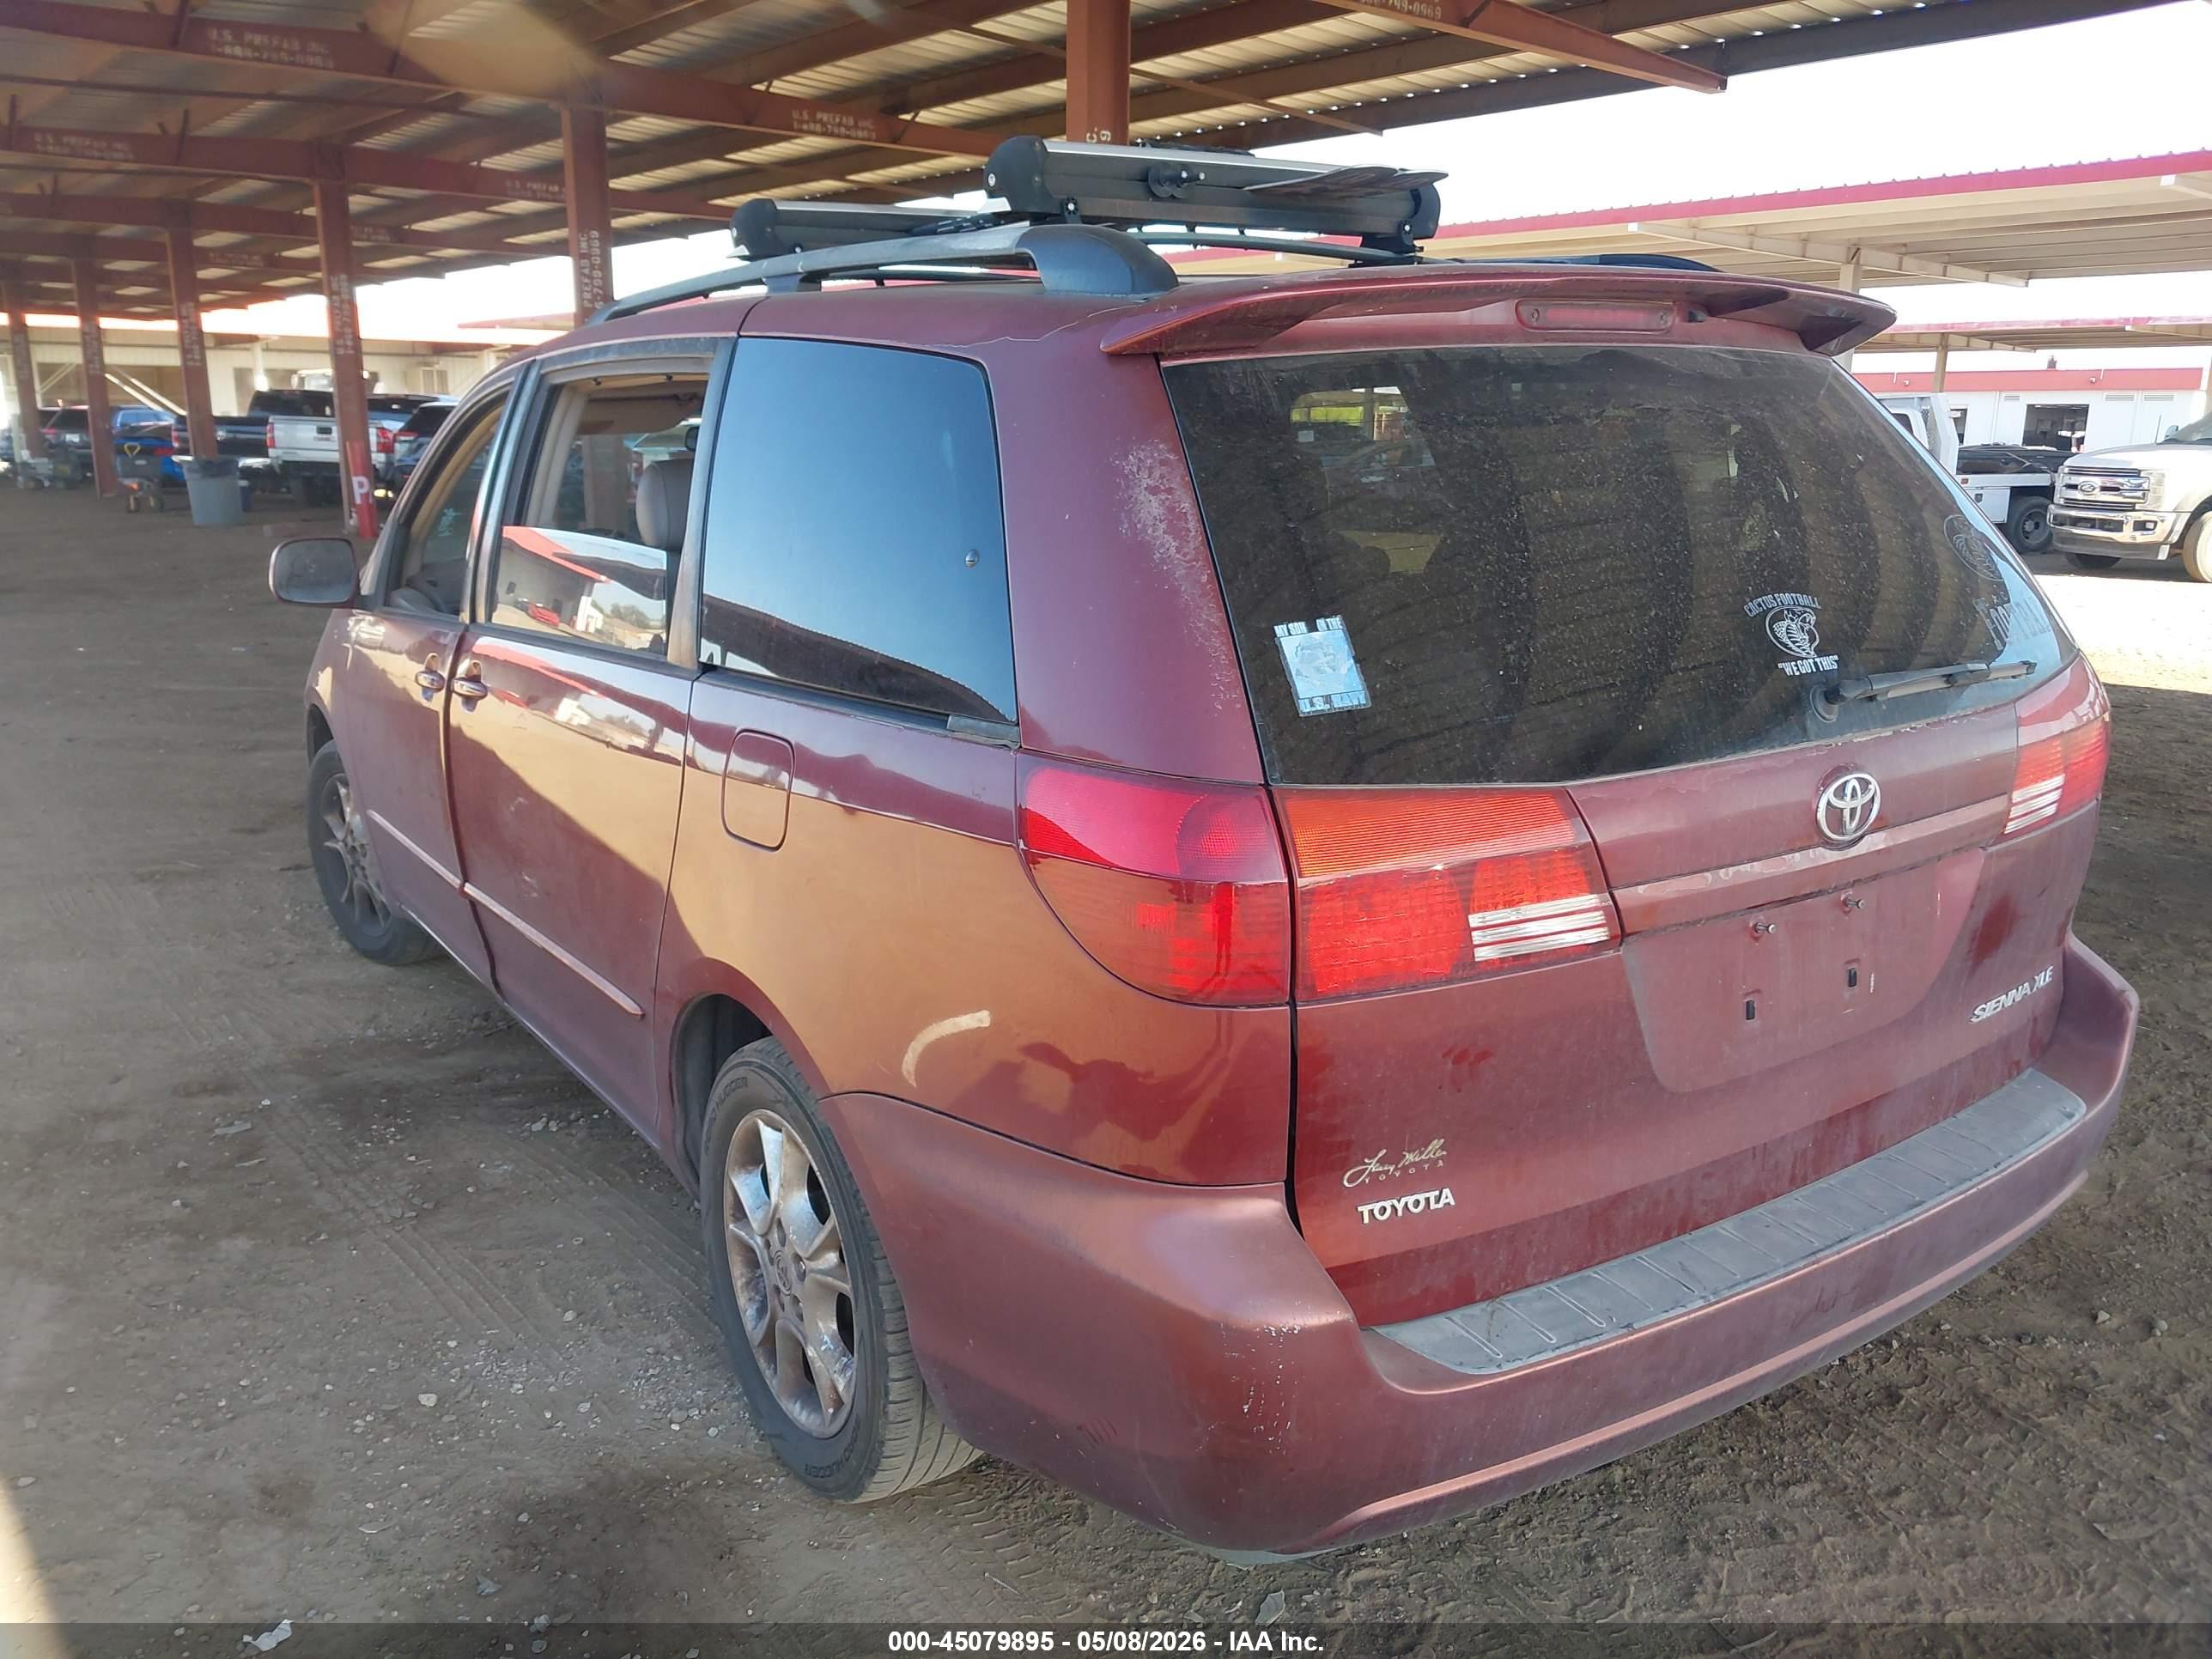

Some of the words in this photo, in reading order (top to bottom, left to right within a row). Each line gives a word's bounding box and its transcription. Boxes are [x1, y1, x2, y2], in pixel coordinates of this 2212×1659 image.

[579, 258, 593, 308] PREFAB
[352, 476, 373, 504] P
[1743, 594, 1776, 617] CACTUS
[1774, 592, 1821, 610] FOOTBALL
[1274, 624, 1289, 638] MY
[1288, 622, 1309, 635] SON
[1326, 617, 1344, 630] THE
[1796, 659, 1817, 675] GOT
[1815, 654, 1839, 672] THIS"
[1331, 690, 1366, 708] NAVY
[1969, 981, 2032, 1024] SIENNA
[2032, 965, 2054, 994] XLE
[1364, 1159, 1444, 1184] TOYOTA
[1357, 1188, 1455, 1224] TOYOTA
